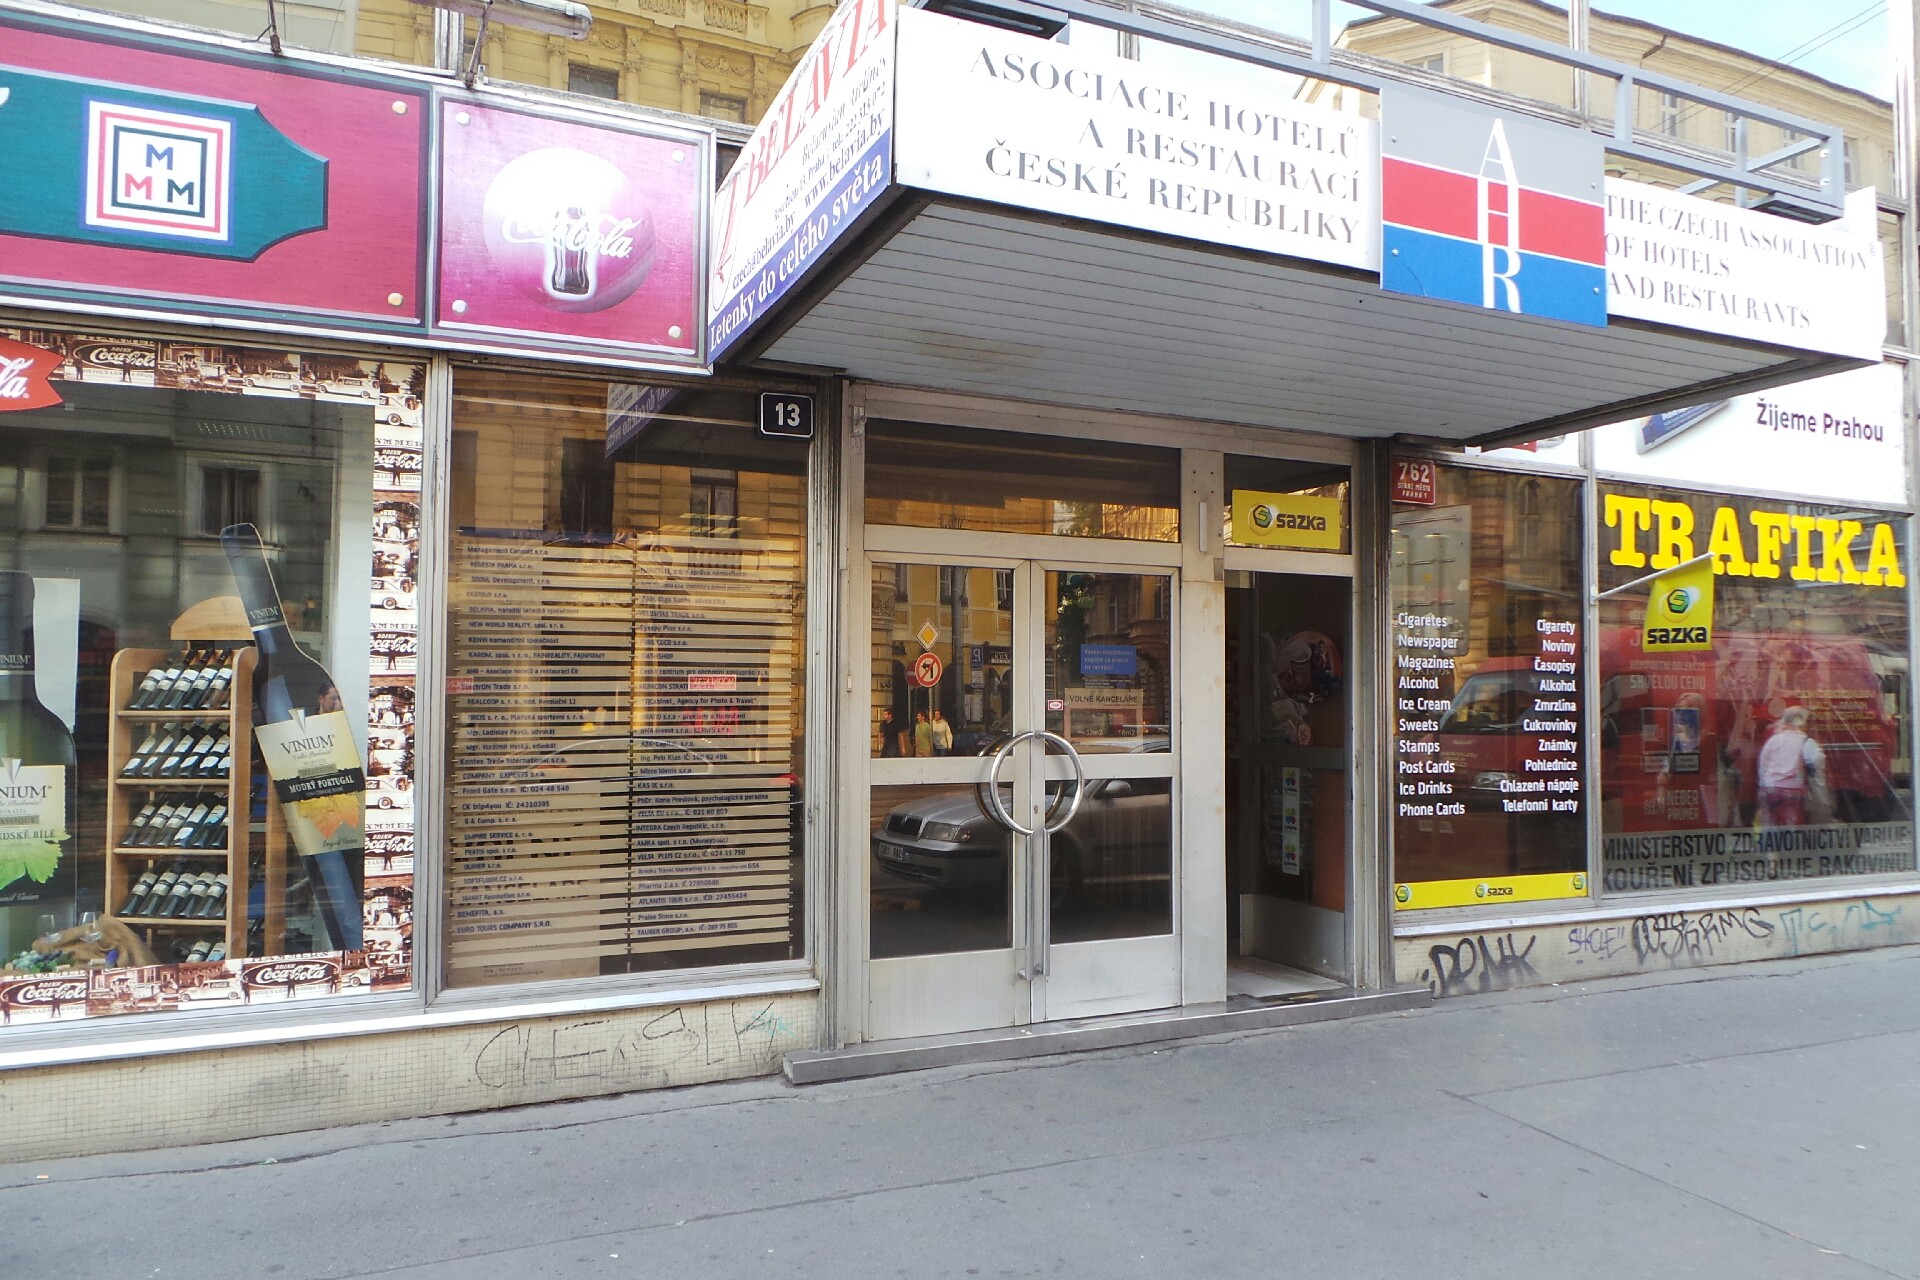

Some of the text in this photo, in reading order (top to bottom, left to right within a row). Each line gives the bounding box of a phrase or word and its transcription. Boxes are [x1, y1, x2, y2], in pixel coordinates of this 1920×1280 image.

[970, 47, 1360, 160] ASOCIACE HOTELŮ
[146, 144, 173, 170] M
[804, 108, 885, 209] www.belavia.by
[1078, 118, 1359, 202] A RESTAURACÍ
[125, 173, 194, 205] M M
[985, 137, 1360, 243] ČESKÉ REPUBLIKY
[501, 212, 643, 258] CCola
[1604, 194, 1652, 225] THE
[1659, 206, 1729, 243] CZECH
[1738, 225, 1867, 270] ASSOCIATION
[710, 154, 884, 352] Letenky do celého světa
[1604, 232, 1731, 277] OF HOTELS
[1607, 271, 1811, 329] AND RESTAURANTS
[775, 402, 800, 427] 13
[1756, 397, 1884, 443] Žijeme Prahou
[1399, 462, 1430, 483] 762
[1276, 511, 1327, 533] sazka
[1604, 493, 1906, 588] TRAFIKA
[249, 605, 279, 620] VINIUM
[1398, 612, 1447, 629] Cigaretes
[1536, 619, 1576, 636] Cigarety
[1647, 626, 1707, 645] sazka
[1398, 634, 1459, 651] Newspaper
[1542, 639, 1576, 655] Noviny
[1398, 655, 1455, 672] Magazines
[1534, 656, 1576, 675] Časopisy
[1399, 676, 1439, 690] Alcohol
[1539, 679, 1576, 692] Alkohol
[677, 697, 698, 705] Agency
[1069, 693, 1138, 703] VOLNÉ KANCELÁŘE
[1399, 698, 1451, 711] Ice Cream
[1534, 699, 1577, 712] Zmrzlina
[1399, 719, 1439, 731] Sweets
[1523, 719, 1577, 733] Cukrovinky
[280, 734, 335, 755] VINIUM
[1399, 740, 1440, 756] Stamps
[1538, 738, 1577, 753] Známky
[1399, 760, 1455, 774] Post Cards
[1524, 759, 1578, 772] Pohlednice
[288, 780, 316, 794] MODRÝ
[317, 775, 355, 789] PORTUGAL
[1399, 782, 1452, 795] Ice Drinks
[1500, 779, 1579, 793] Chlazené nápoje
[473, 802, 502, 810] trip4you
[1399, 802, 1465, 817] Phone Cards
[1502, 799, 1578, 814] Telefonní karty
[33, 828, 56, 840] BÍLÉ
[636, 823, 661, 831] INTEGRA
[1602, 833, 1726, 861] MINISTERSTVO
[1602, 859, 1694, 890] KOUŘENÍ
[1700, 856, 1813, 885] ZPŮSOBUJE
[1487, 887, 1513, 897] sazka
[477, 924, 497, 932] TOURS
[499, 922, 531, 930] COMPANY
[257, 965, 329, 985] Coca-Cola
